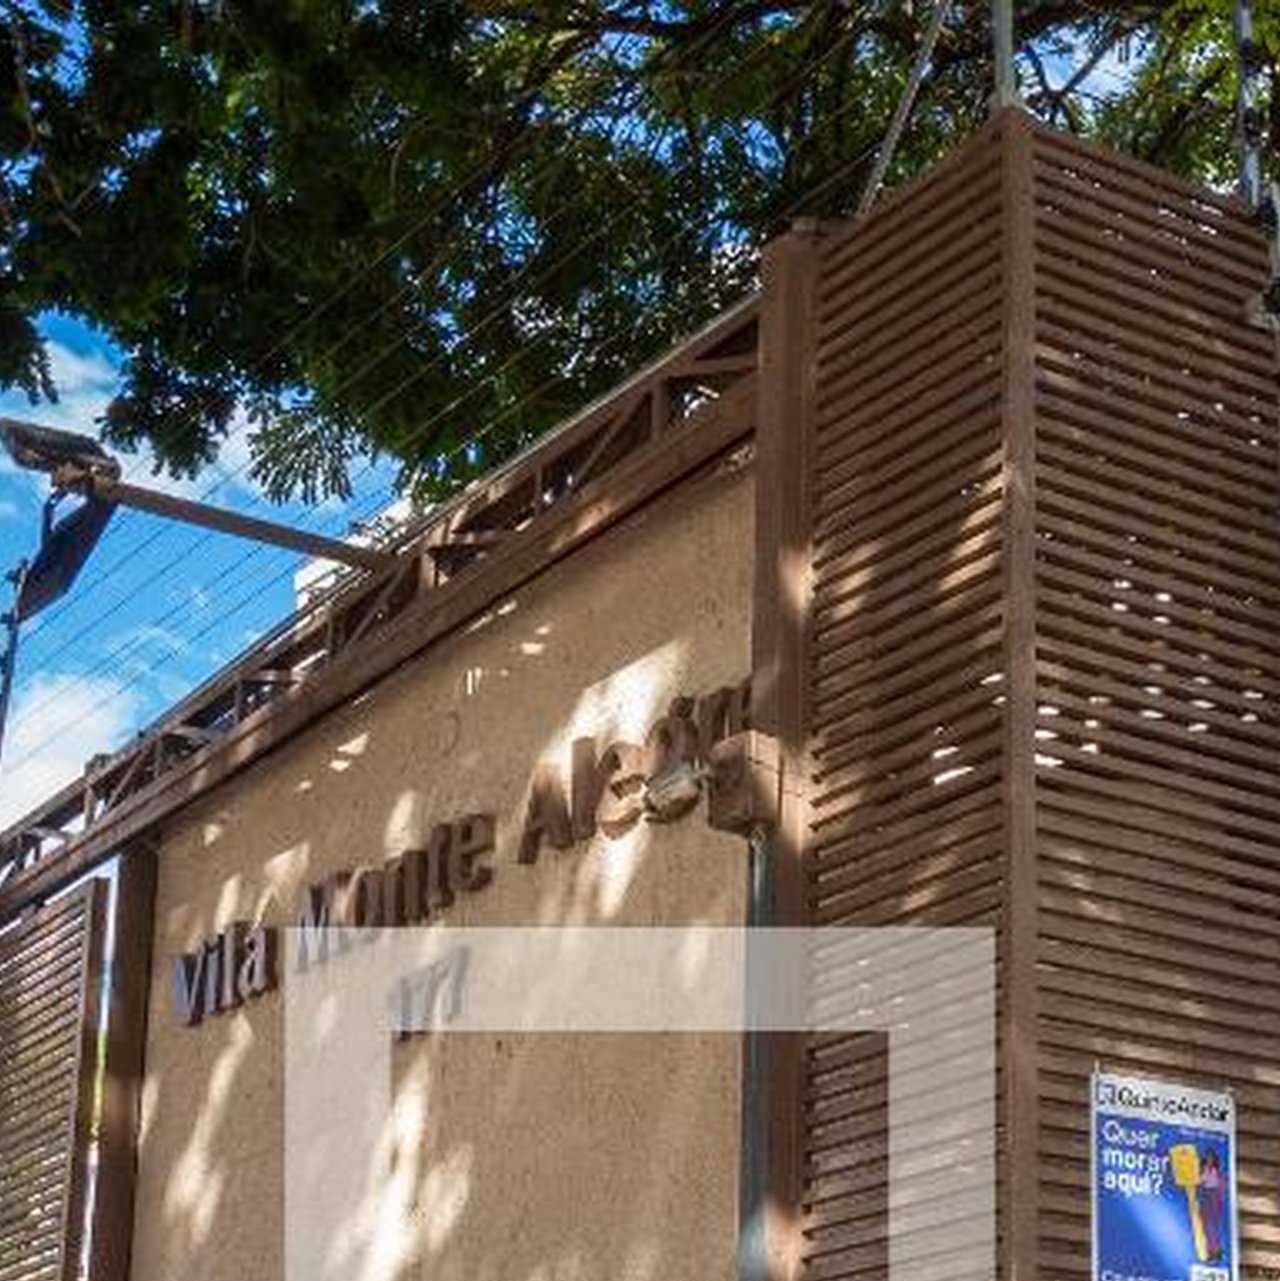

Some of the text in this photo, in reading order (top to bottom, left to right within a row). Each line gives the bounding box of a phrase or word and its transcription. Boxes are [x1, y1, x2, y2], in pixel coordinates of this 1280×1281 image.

[174, 921, 277, 1028] Vila
[297, 814, 497, 973] Monte
[1102, 1120, 1160, 1149] Quer
[1102, 1147, 1170, 1173] morar
[1104, 1170, 1164, 1198] aqui?
